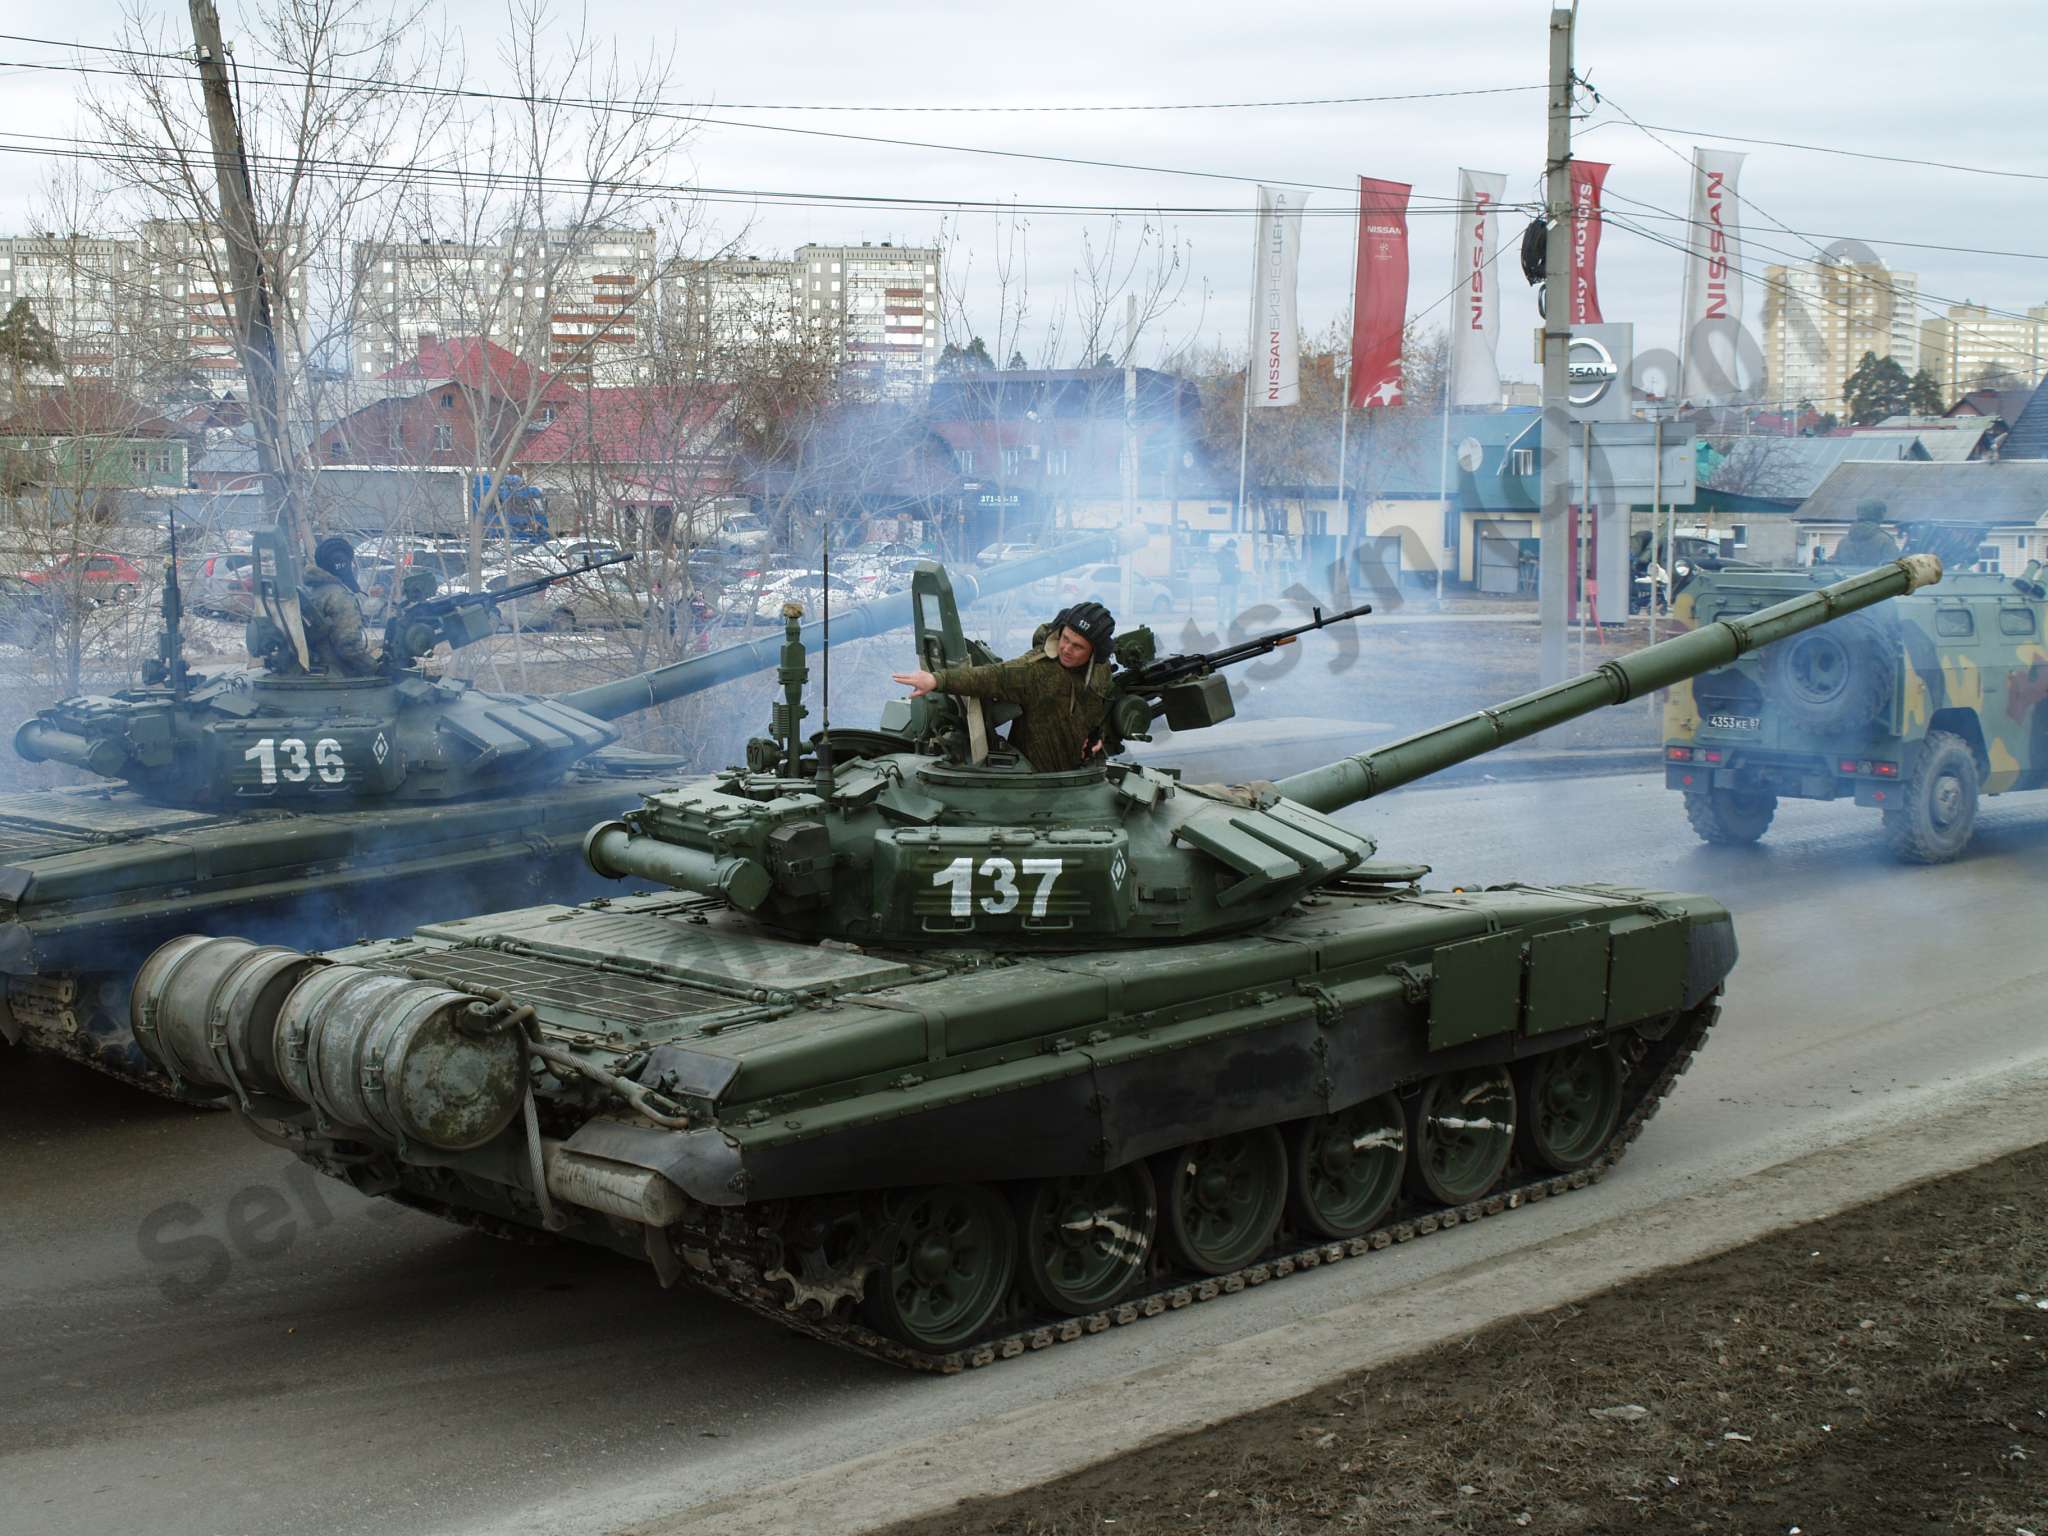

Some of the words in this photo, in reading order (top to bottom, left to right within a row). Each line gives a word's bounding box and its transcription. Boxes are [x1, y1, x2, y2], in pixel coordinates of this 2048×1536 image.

[1366, 225, 1402, 236] NISSAN
[1575, 183, 1593, 268] Motors
[1706, 171, 1728, 320] NISSAN
[1471, 191, 1491, 331] NISSAN
[1568, 366, 1608, 378] SSAN
[1711, 716, 1735, 728] 4353
[243, 737, 347, 785] 136
[931, 857, 1063, 918] 137
